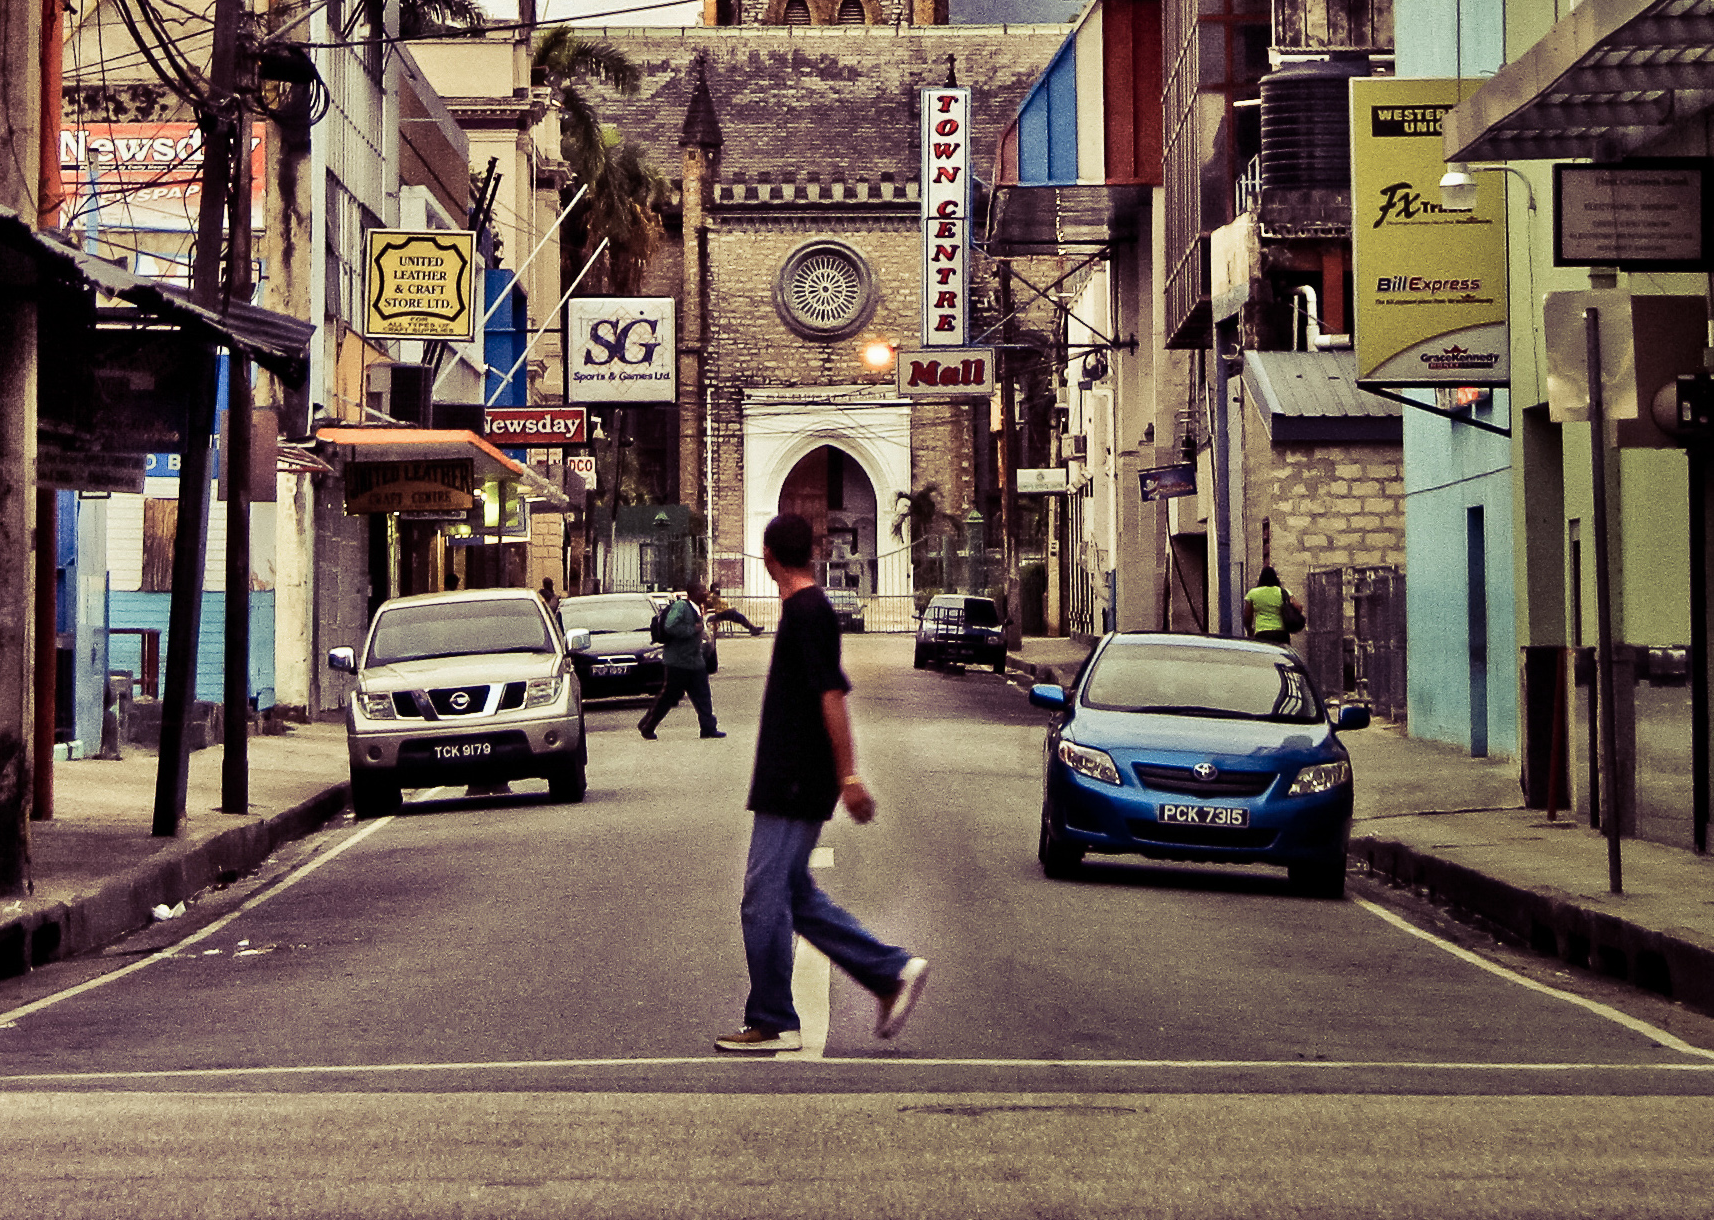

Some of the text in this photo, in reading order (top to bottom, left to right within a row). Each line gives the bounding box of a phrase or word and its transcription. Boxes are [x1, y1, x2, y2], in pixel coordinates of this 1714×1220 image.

[1377, 108, 1446, 121] WESTER
[931, 95, 961, 332] TOWN CENTRE
[399, 256, 444, 267] UNITED
[393, 270, 447, 281] LEATHER
[394, 284, 447, 295] & CRAFT
[384, 298, 453, 309] STORE LTD.
[573, 371, 606, 383] Sports
[608, 371, 616, 380] &
[619, 371, 653, 381] Games
[907, 358, 986, 387] Mall
[434, 742, 491, 759] TCK 9179
[1164, 805, 1243, 825] PCK 7315
